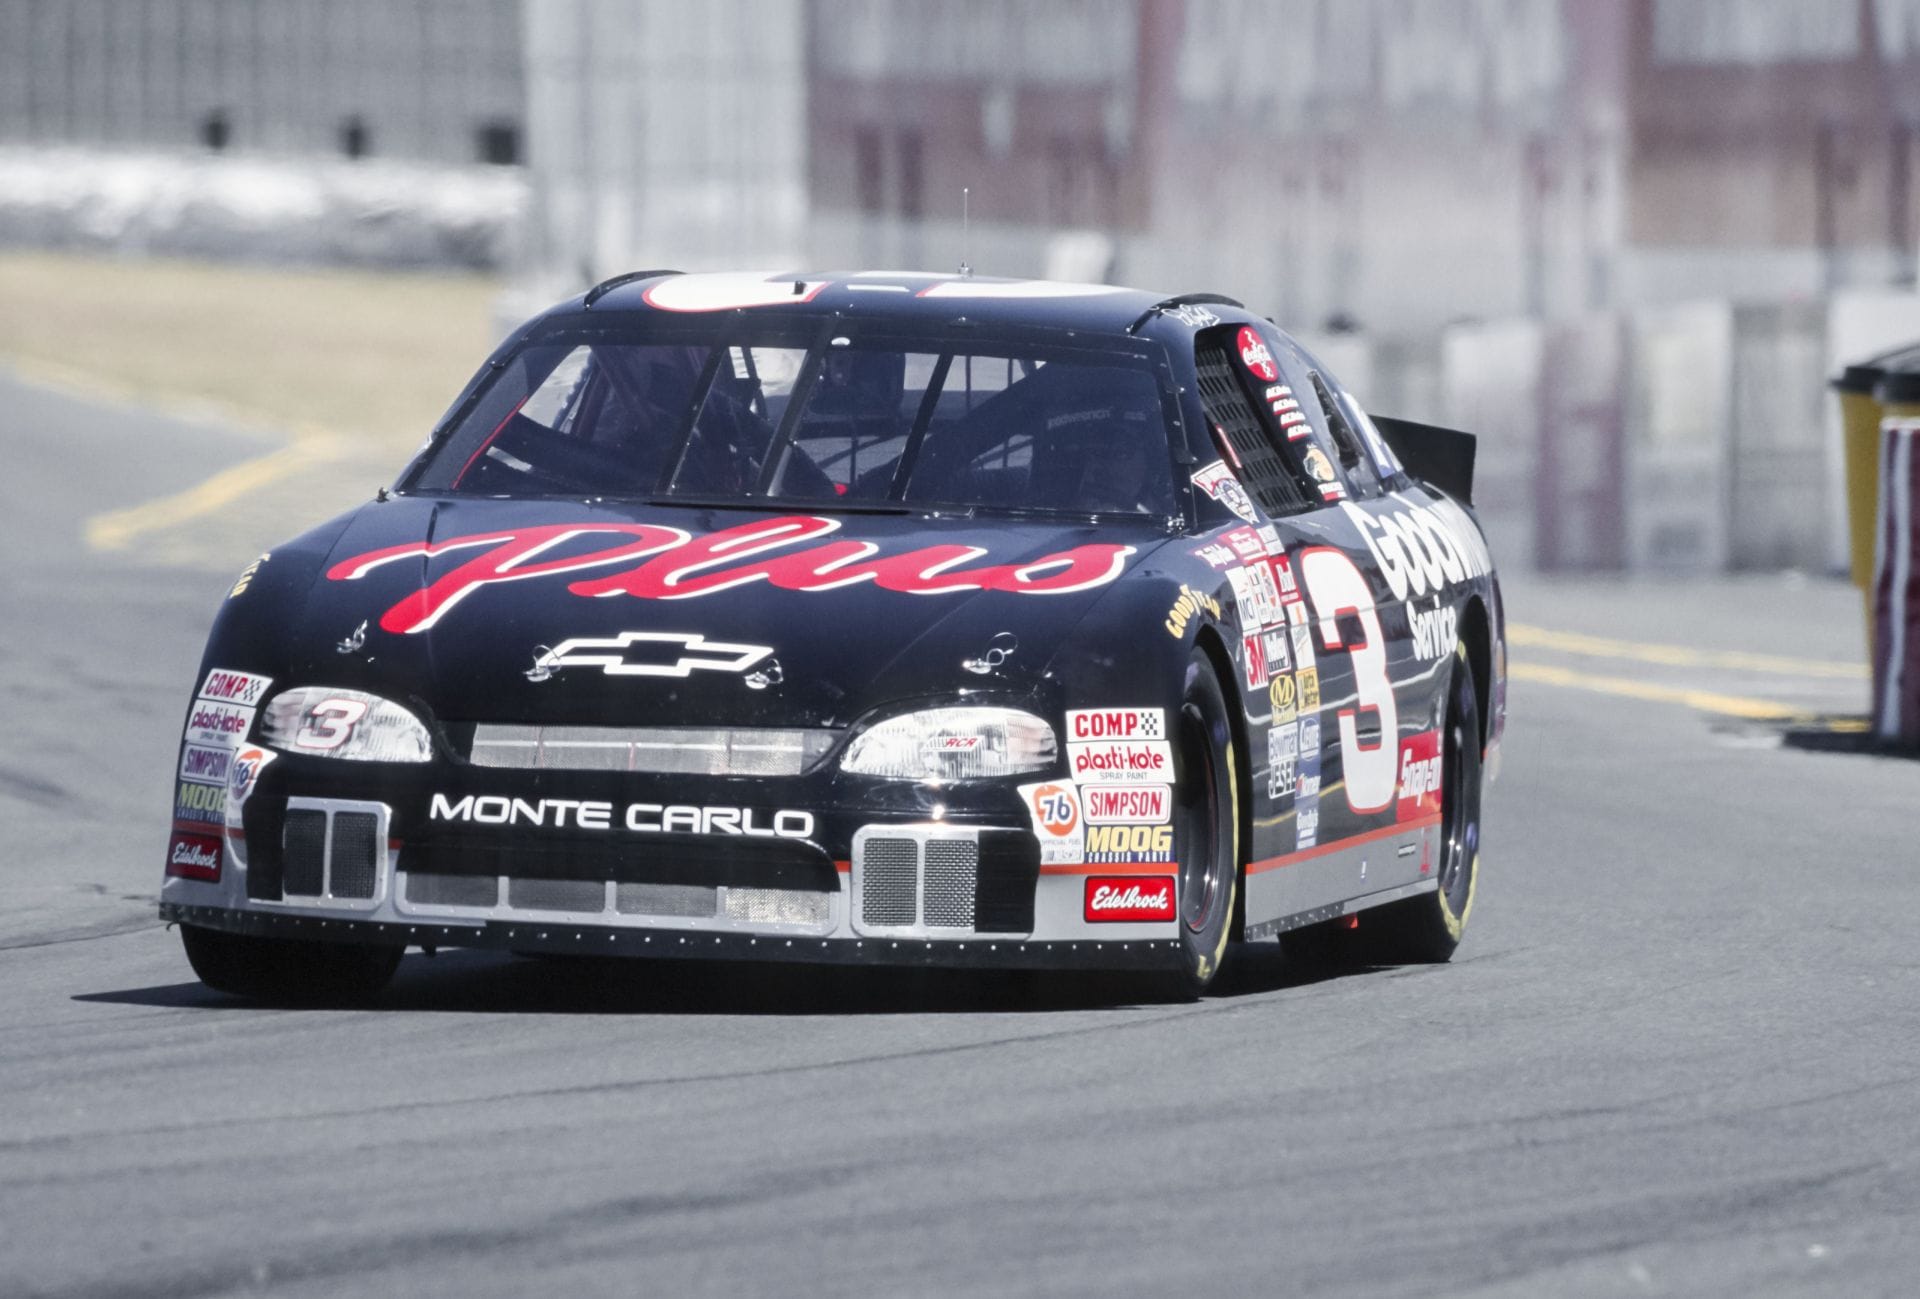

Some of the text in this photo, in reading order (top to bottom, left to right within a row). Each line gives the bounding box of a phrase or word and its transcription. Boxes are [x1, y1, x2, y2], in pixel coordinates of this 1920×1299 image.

[326, 516, 1137, 635] Plus
[1407, 595, 1458, 661] Service
[1245, 633, 1268, 686] 3M
[204, 672, 248, 699] COMP
[1301, 546, 1398, 814] 3
[296, 699, 368, 751] 3
[1075, 713, 1138, 738] COMP
[185, 748, 227, 778] SIMPSON
[1099, 771, 1148, 781] SPRAY PAINT
[179, 784, 227, 811] MOOG
[1043, 795, 1072, 821] 76
[1090, 791, 1163, 817] SIMPSON
[429, 793, 815, 838] MONTE CARLO
[1086, 826, 1173, 853] MOOG
[172, 842, 217, 869] Edelbrock
[1088, 851, 1131, 863] CHASSIS
[1138, 851, 1170, 863] PARTS
[1092, 886, 1168, 910] Edelbrock
